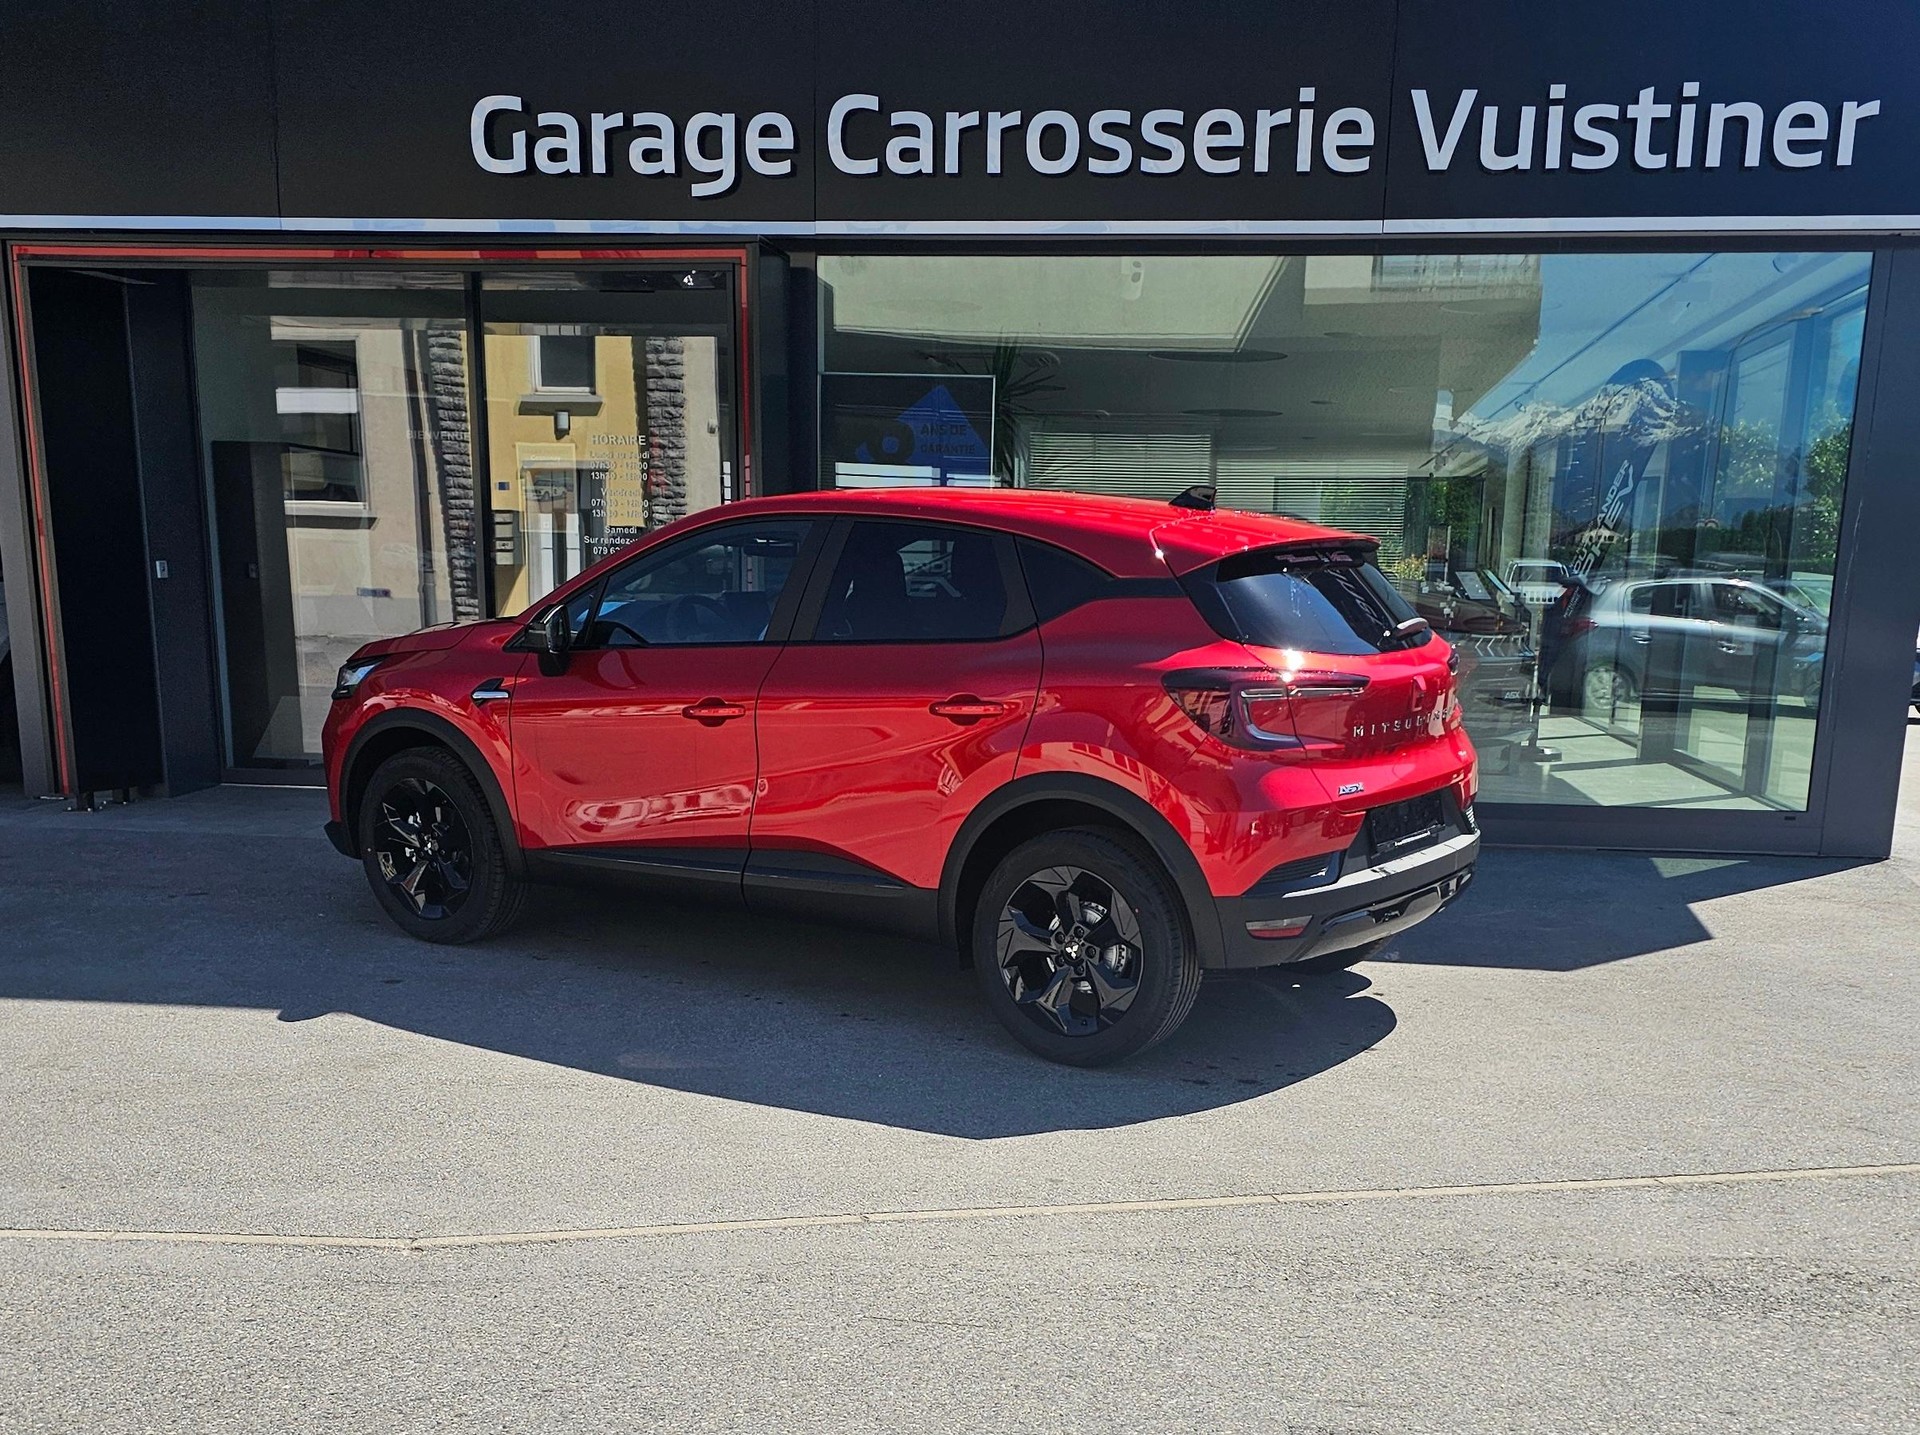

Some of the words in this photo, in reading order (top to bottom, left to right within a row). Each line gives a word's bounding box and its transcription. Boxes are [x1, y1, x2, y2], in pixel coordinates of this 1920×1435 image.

[471, 95, 793, 196] Garage
[828, 87, 1374, 174] Carrosserie
[1411, 82, 1880, 170] Vuistiner
[591, 434, 647, 446] HORAIRE
[920, 443, 976, 455] GARANTIE
[604, 526, 637, 534] Samedi
[583, 535, 598, 544] Sur
[593, 546, 608, 555] 079
